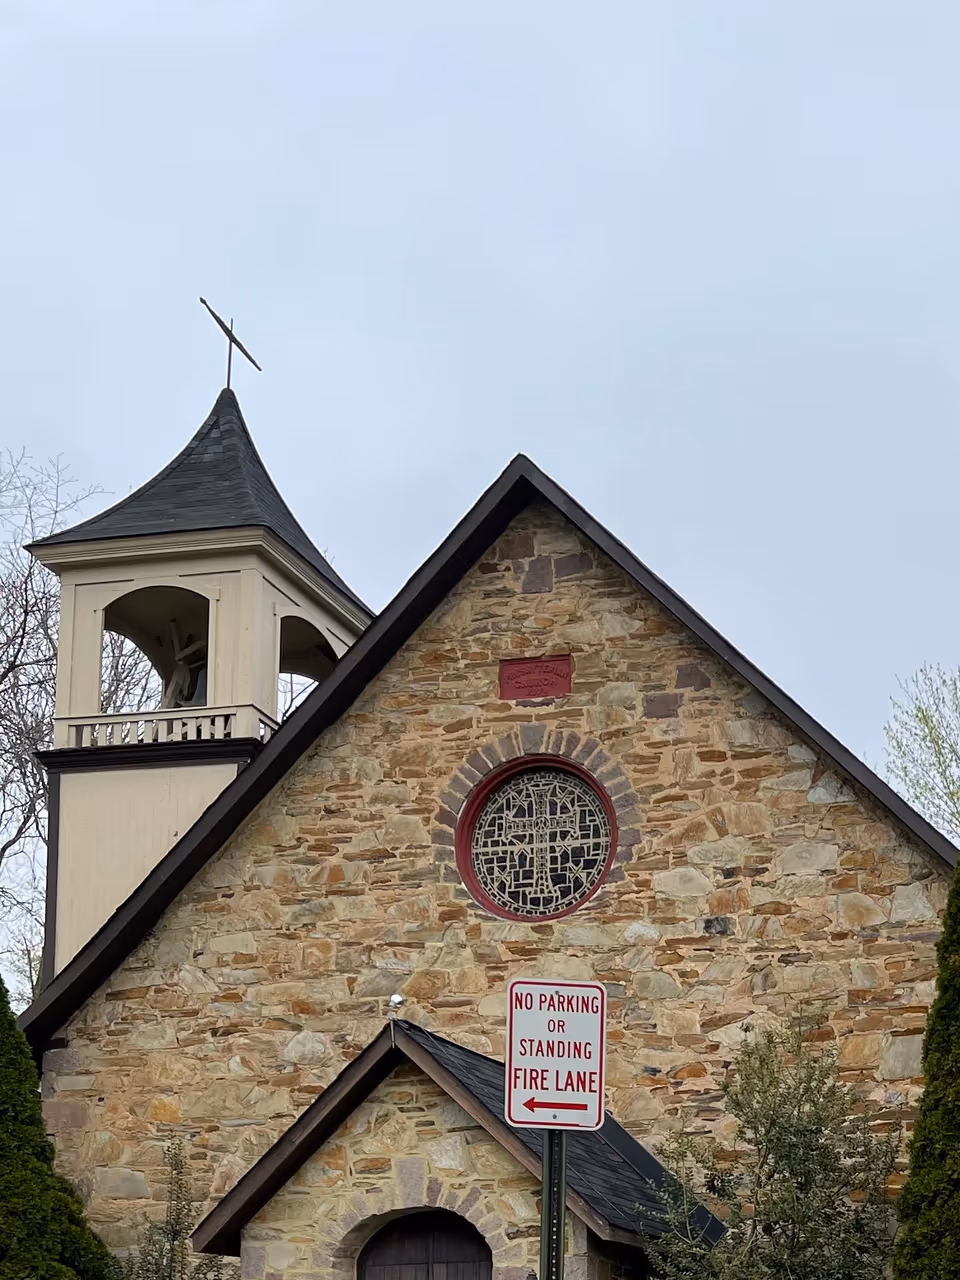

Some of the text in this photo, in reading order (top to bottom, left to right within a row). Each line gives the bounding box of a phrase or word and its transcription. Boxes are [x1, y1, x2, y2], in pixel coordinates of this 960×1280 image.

[515, 992, 599, 1014] NO PARKING
[547, 1019, 565, 1033] OR
[519, 1039, 592, 1060] STANDING
[513, 1068, 598, 1093] FIRE LANE
